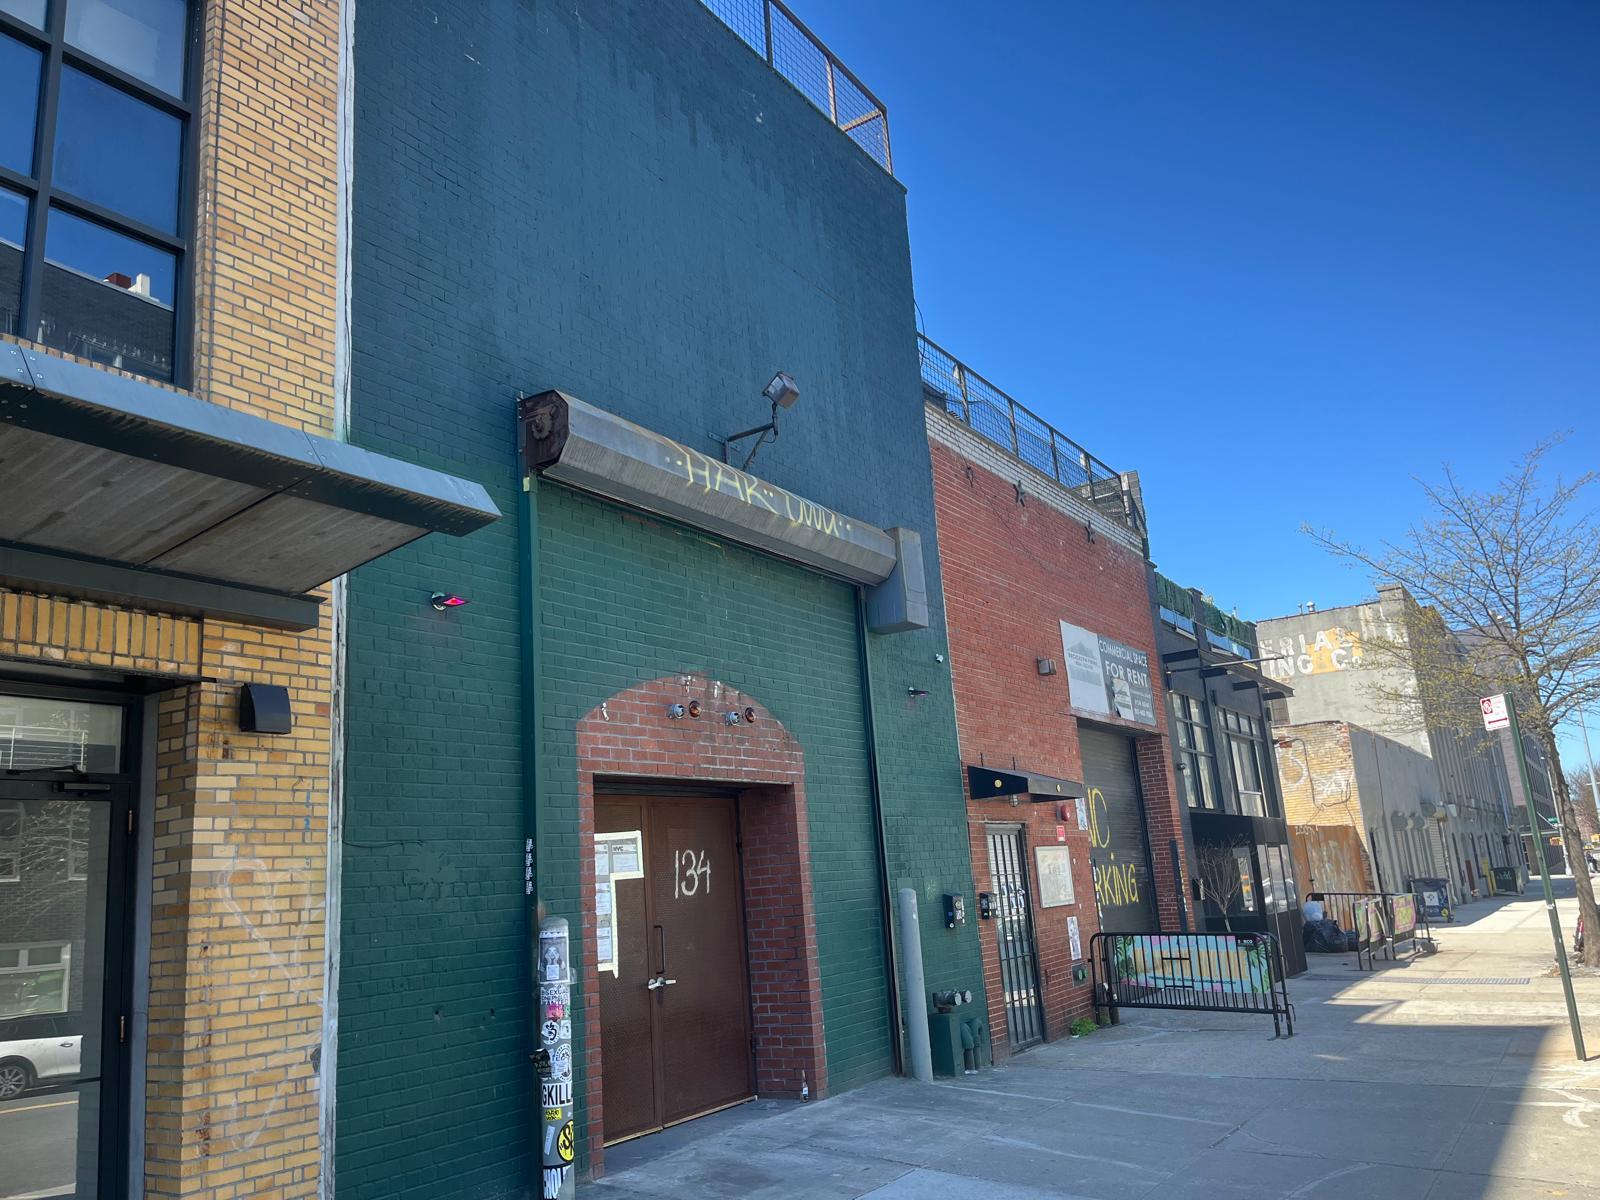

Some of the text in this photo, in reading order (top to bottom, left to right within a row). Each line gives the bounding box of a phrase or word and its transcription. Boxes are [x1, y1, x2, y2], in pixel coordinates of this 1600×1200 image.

[1099, 640, 1134, 663] COMMERCIAL
[1133, 651, 1148, 668] SPACE
[1105, 660, 1126, 681] FOR
[1126, 667, 1148, 688] RENT
[674, 849, 711, 899] 134
